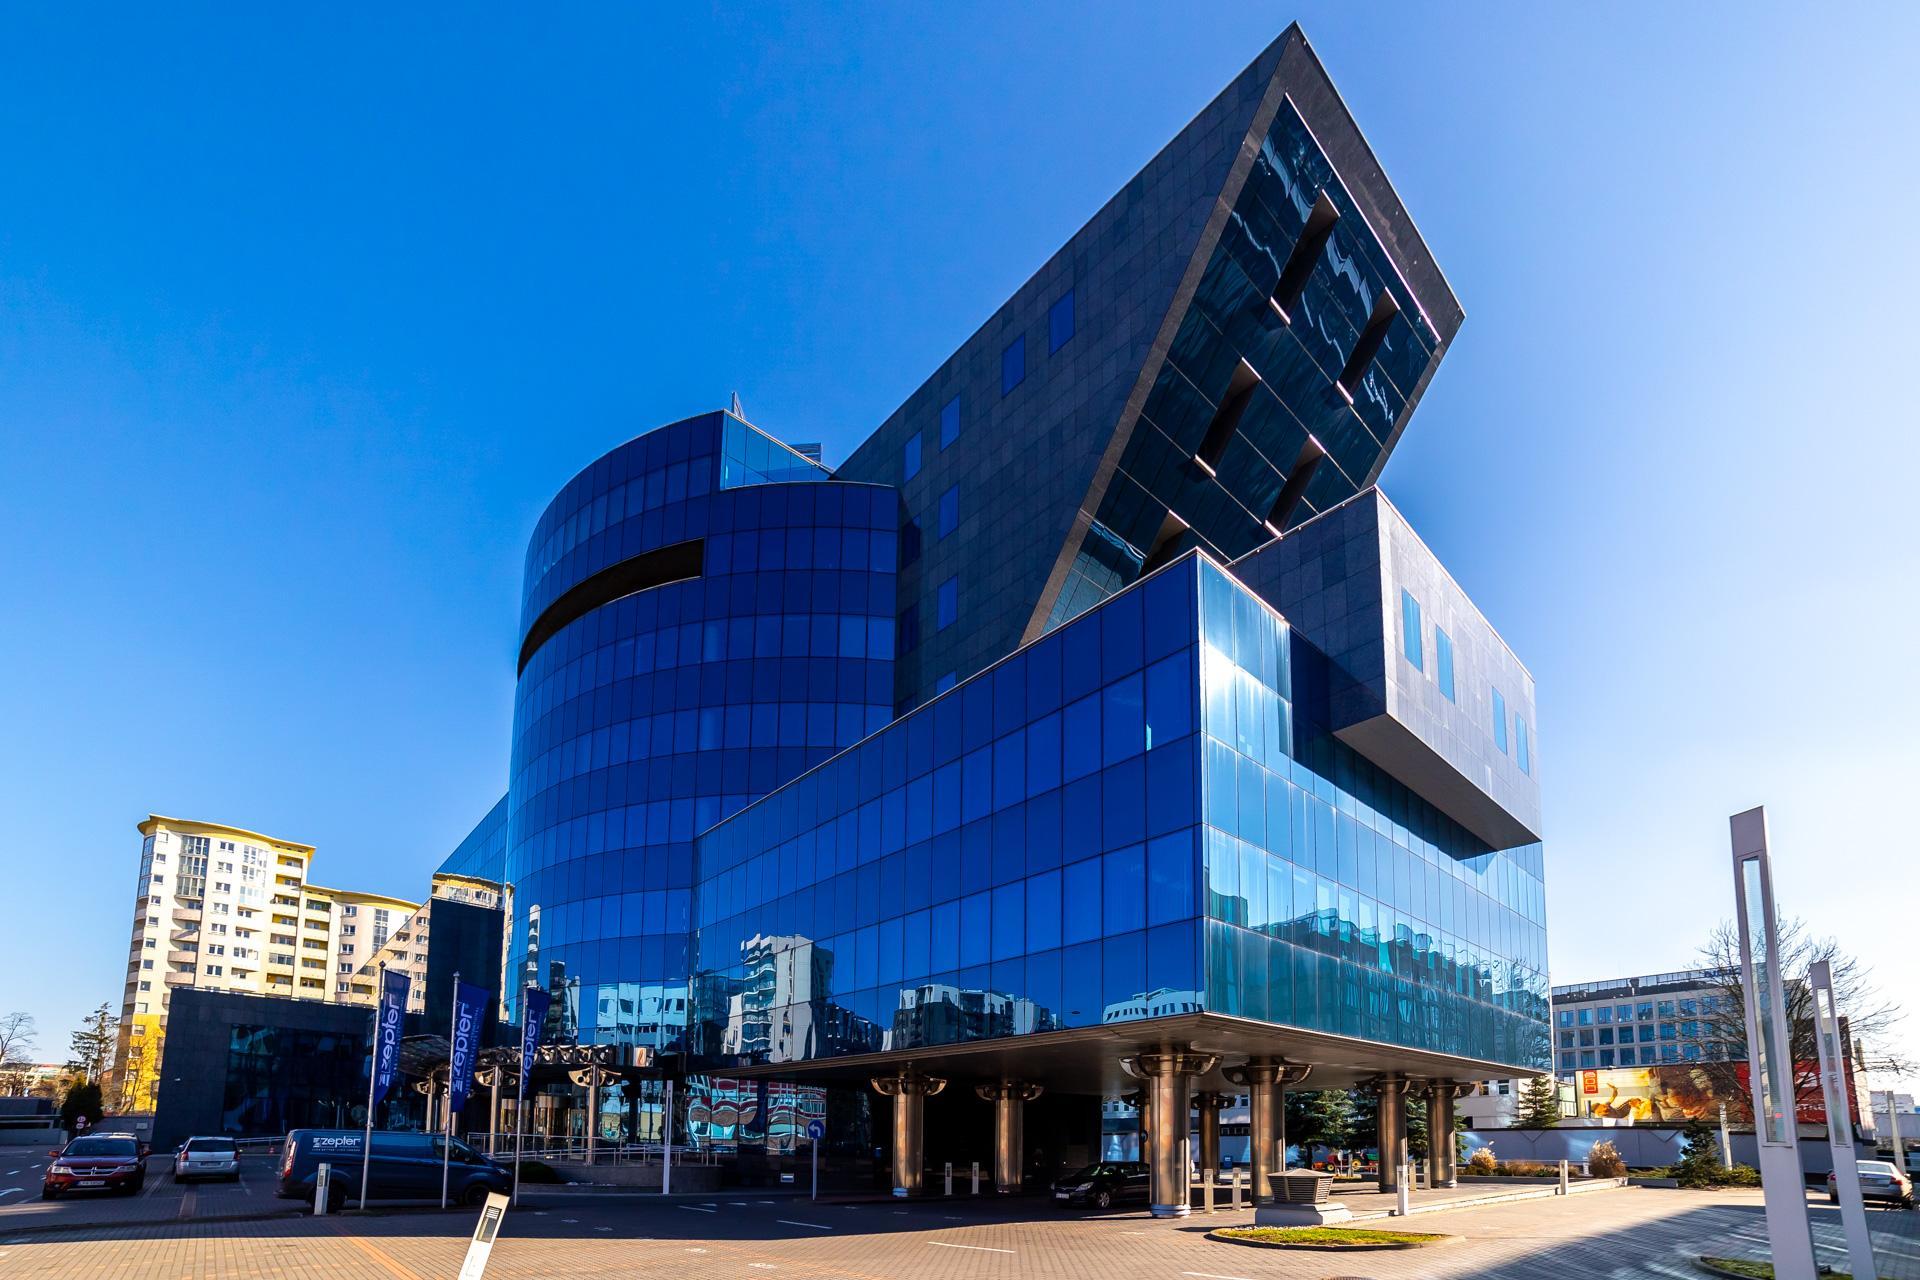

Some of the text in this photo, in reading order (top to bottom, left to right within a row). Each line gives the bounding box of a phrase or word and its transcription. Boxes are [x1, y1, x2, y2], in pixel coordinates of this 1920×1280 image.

[382, 993, 400, 1070] zepter
[454, 1003, 473, 1077] zepter
[321, 1135, 361, 1148] zepter
